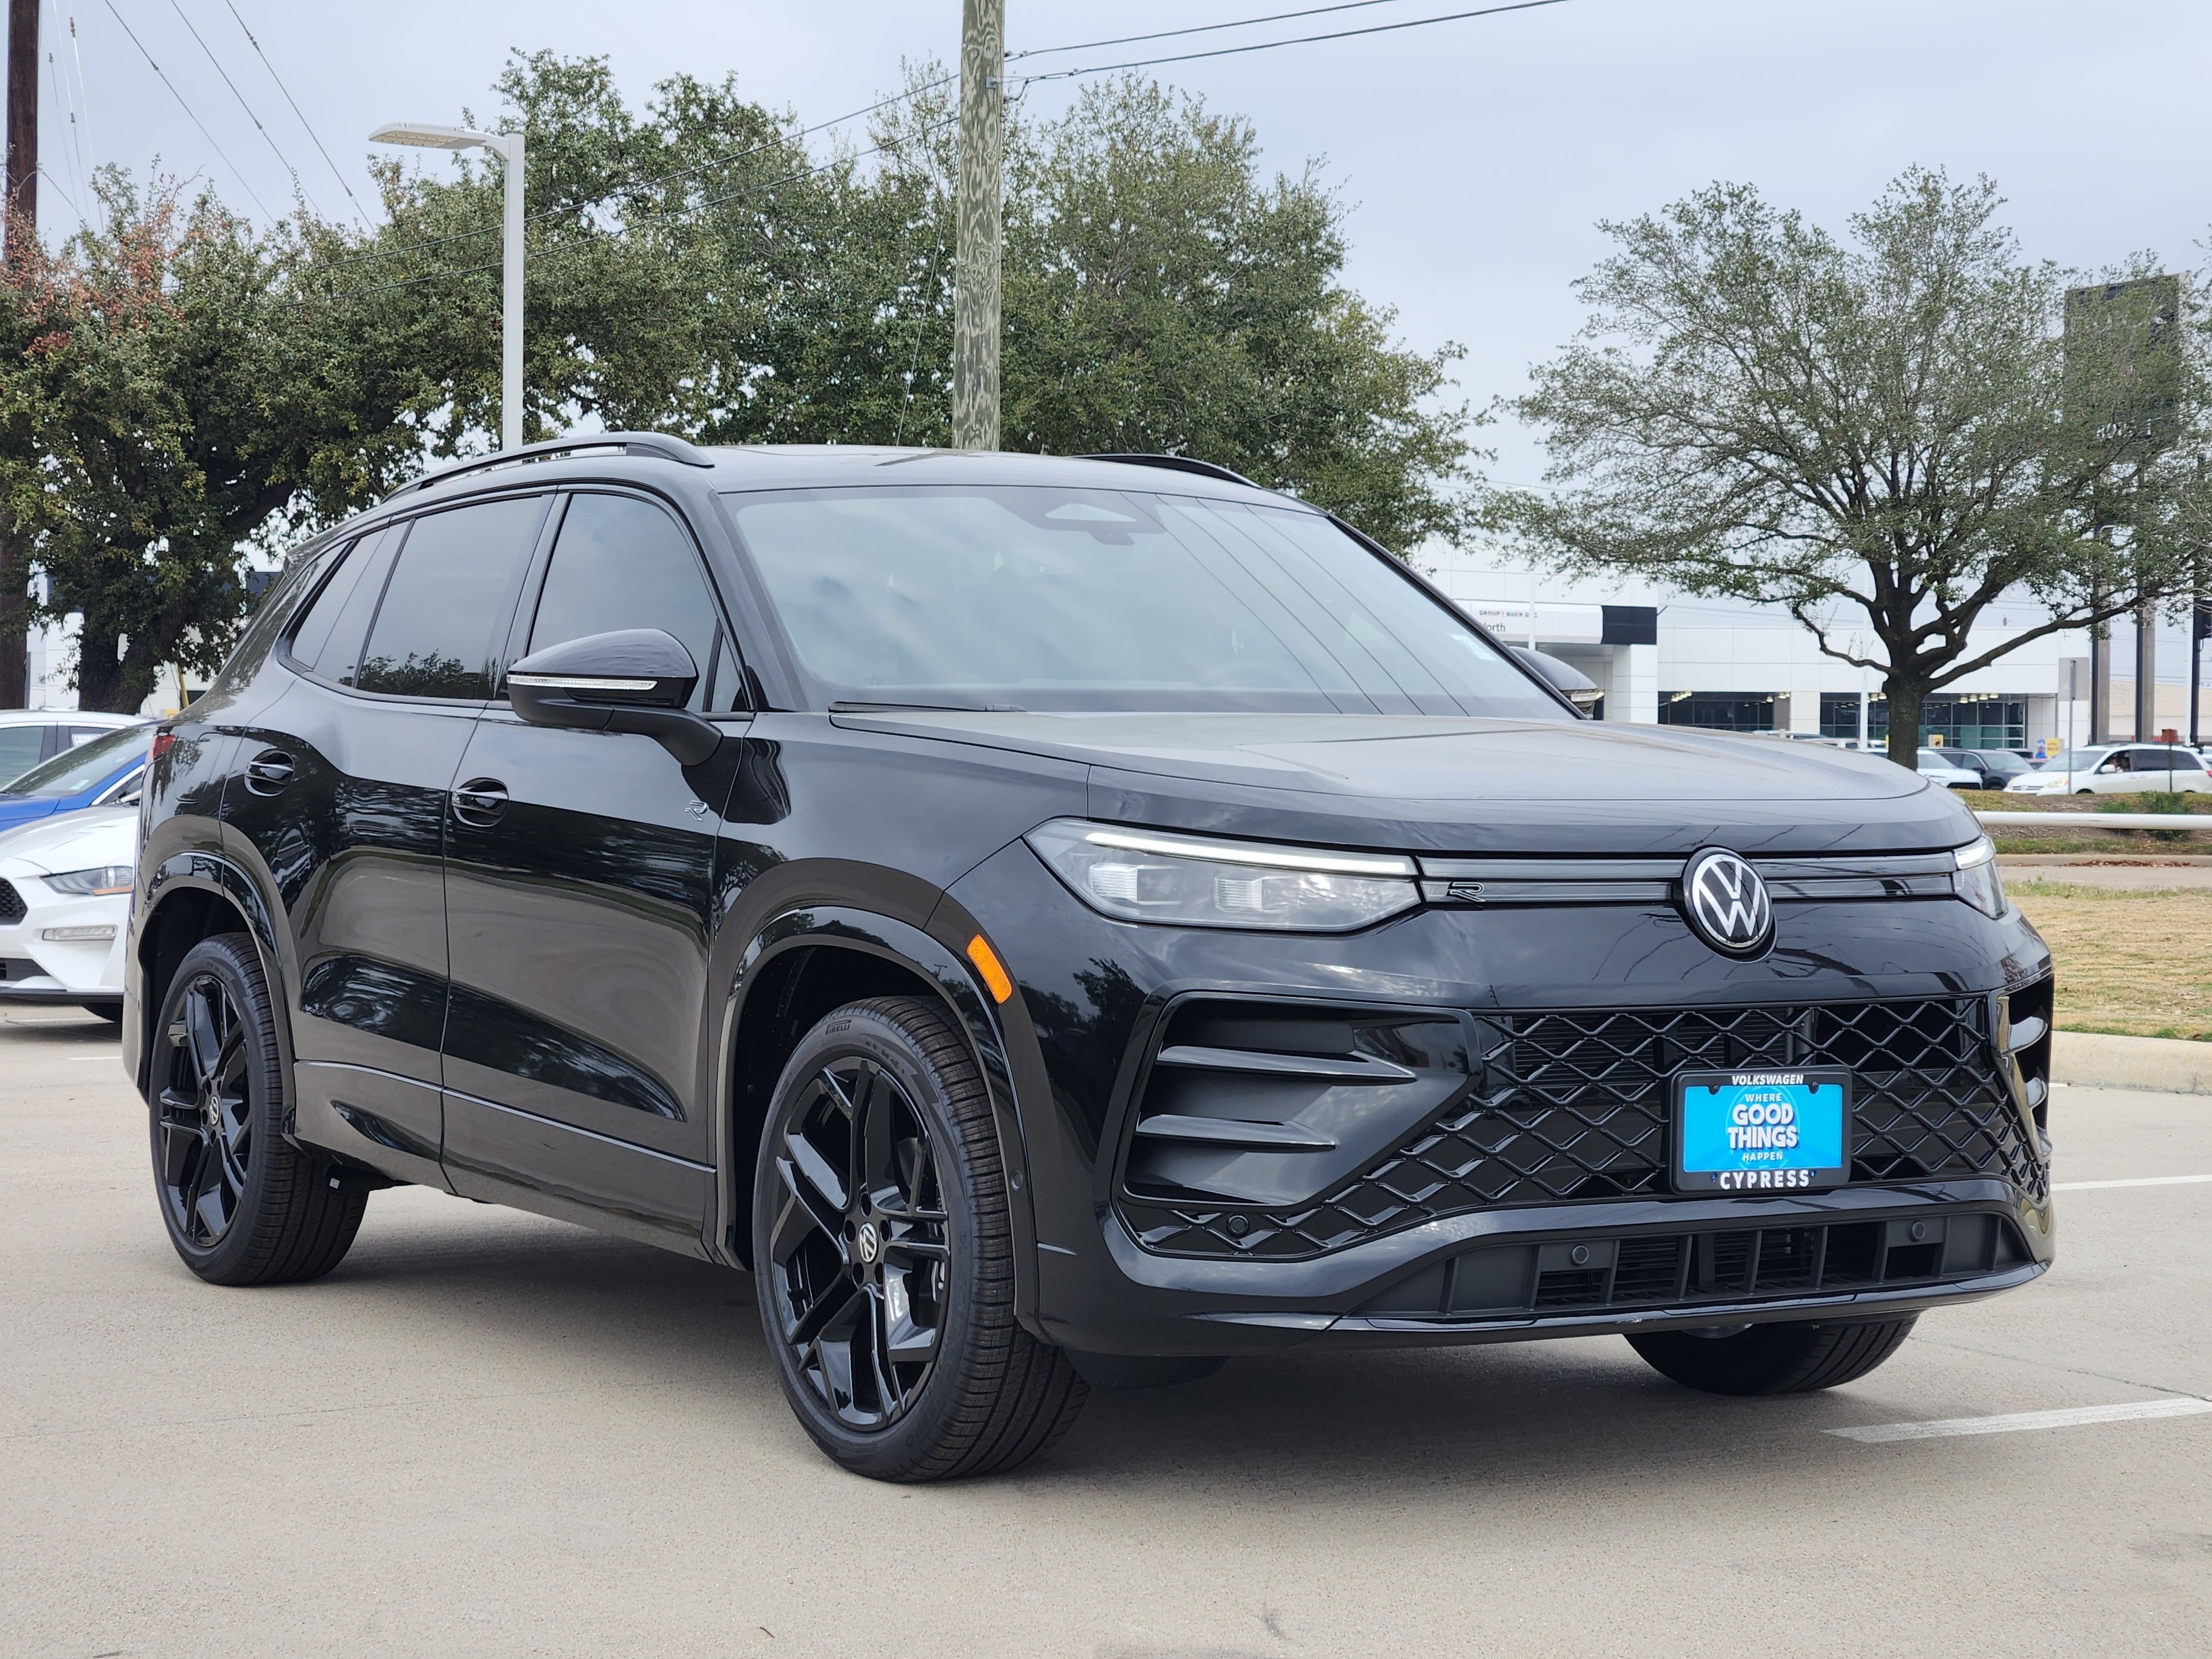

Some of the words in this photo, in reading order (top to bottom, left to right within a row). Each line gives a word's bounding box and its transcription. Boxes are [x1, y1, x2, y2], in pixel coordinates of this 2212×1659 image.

[1692, 853, 1770, 947] VW
[826, 1019, 852, 1035] PIRELLI
[1732, 1074, 1804, 1086] VOLKSWAGEN
[1745, 1093, 1782, 1103] WHERE
[1732, 1104, 1794, 1126] GOOD
[1728, 1125, 1799, 1150] THINGS
[1742, 1152, 1783, 1162] HAPPEN
[1720, 1170, 1811, 1190] CYPRESS
